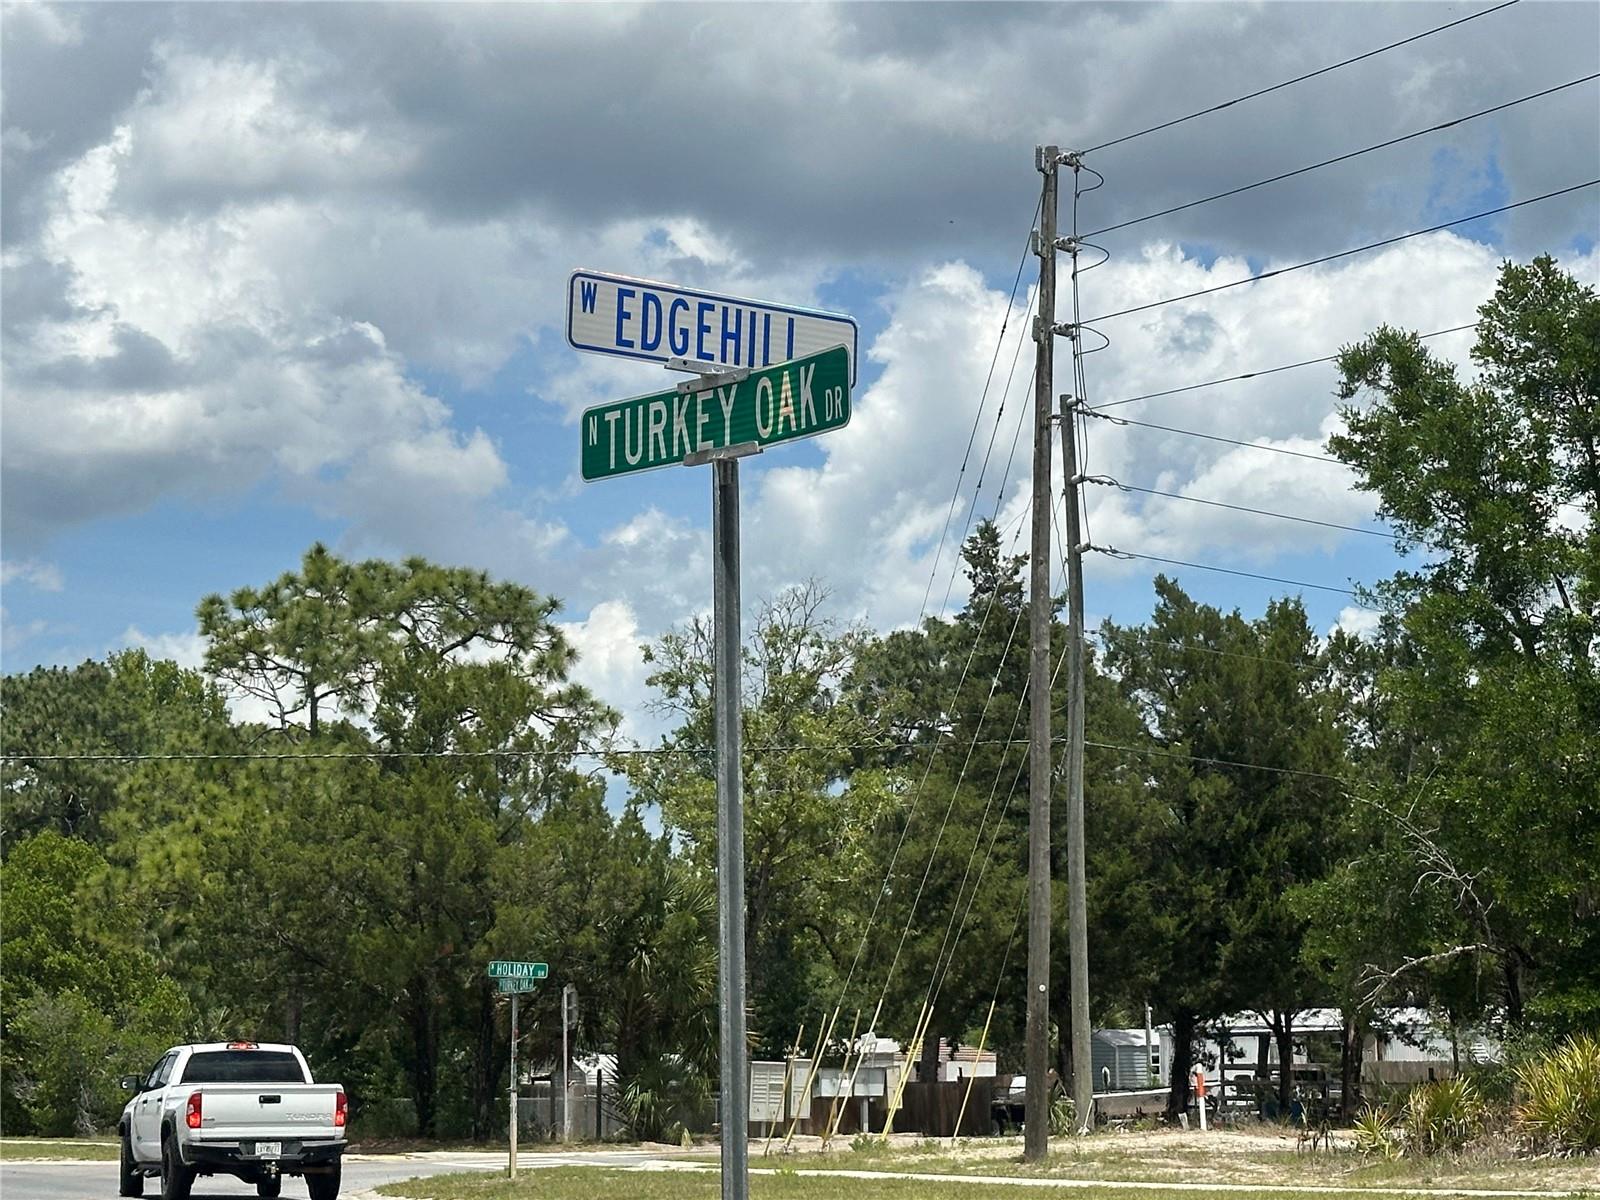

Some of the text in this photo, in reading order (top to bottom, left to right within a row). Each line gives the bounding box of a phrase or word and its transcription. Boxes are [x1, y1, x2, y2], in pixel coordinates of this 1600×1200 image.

[581, 281, 598, 314] W
[589, 362, 843, 469] N TURKEY OAK DR
[496, 963, 535, 977] HOLIDAY
[285, 1112, 333, 1121] TUNDRA
